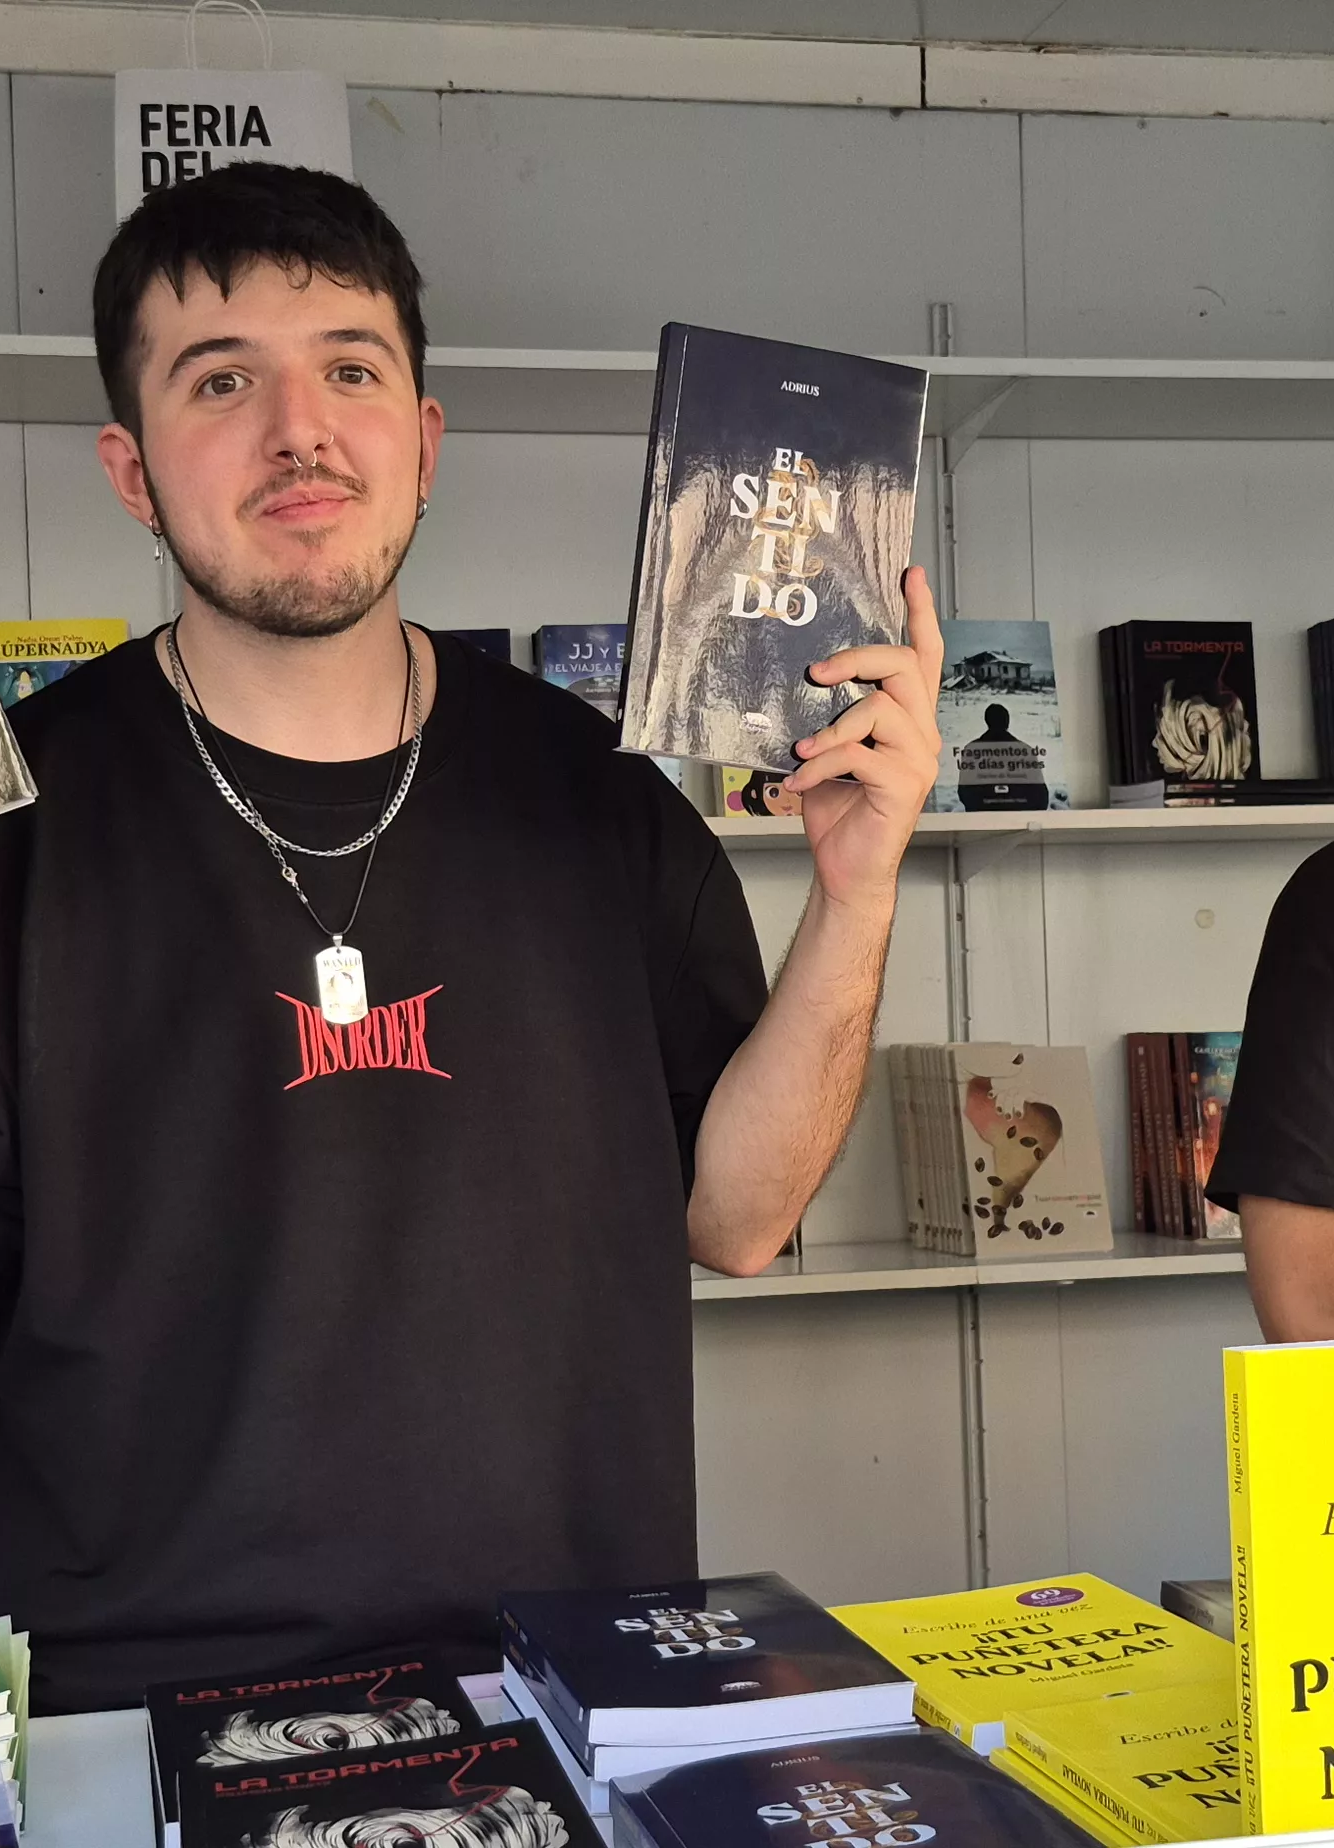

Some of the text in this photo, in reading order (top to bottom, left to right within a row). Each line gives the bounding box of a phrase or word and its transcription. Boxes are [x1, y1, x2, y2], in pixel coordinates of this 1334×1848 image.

[139, 103, 273, 147] FERIA
[779, 379, 821, 398] ADRIUS
[774, 446, 807, 475] EL
[730, 472, 843, 536] SEN
[727, 572, 819, 627] DO
[1143, 640, 1245, 654] LA TORMENTA
[572, 663, 601, 673] VIAJE
[952, 745, 1047, 760] Fragmentos de
[957, 759, 1046, 772] los días grises
[1233, 1446, 1244, 1495] Miguel
[614, 1608, 740, 1633] SEN
[902, 1602, 1094, 1635] Escribe de una vez
[650, 1636, 757, 1659] DO
[907, 1621, 1169, 1666] PUÑETERA
[949, 1637, 1175, 1680] NOVELA!!
[1236, 1545, 1253, 1743] PUÑETERA NOVELA!!
[176, 1689, 220, 1703] LA
[228, 1662, 424, 1696] TORMENTA
[1119, 1723, 1211, 1746] Escribe
[214, 1776, 268, 1795] LA
[279, 1737, 519, 1787] TORMENTA
[757, 1782, 913, 1826] SEN
